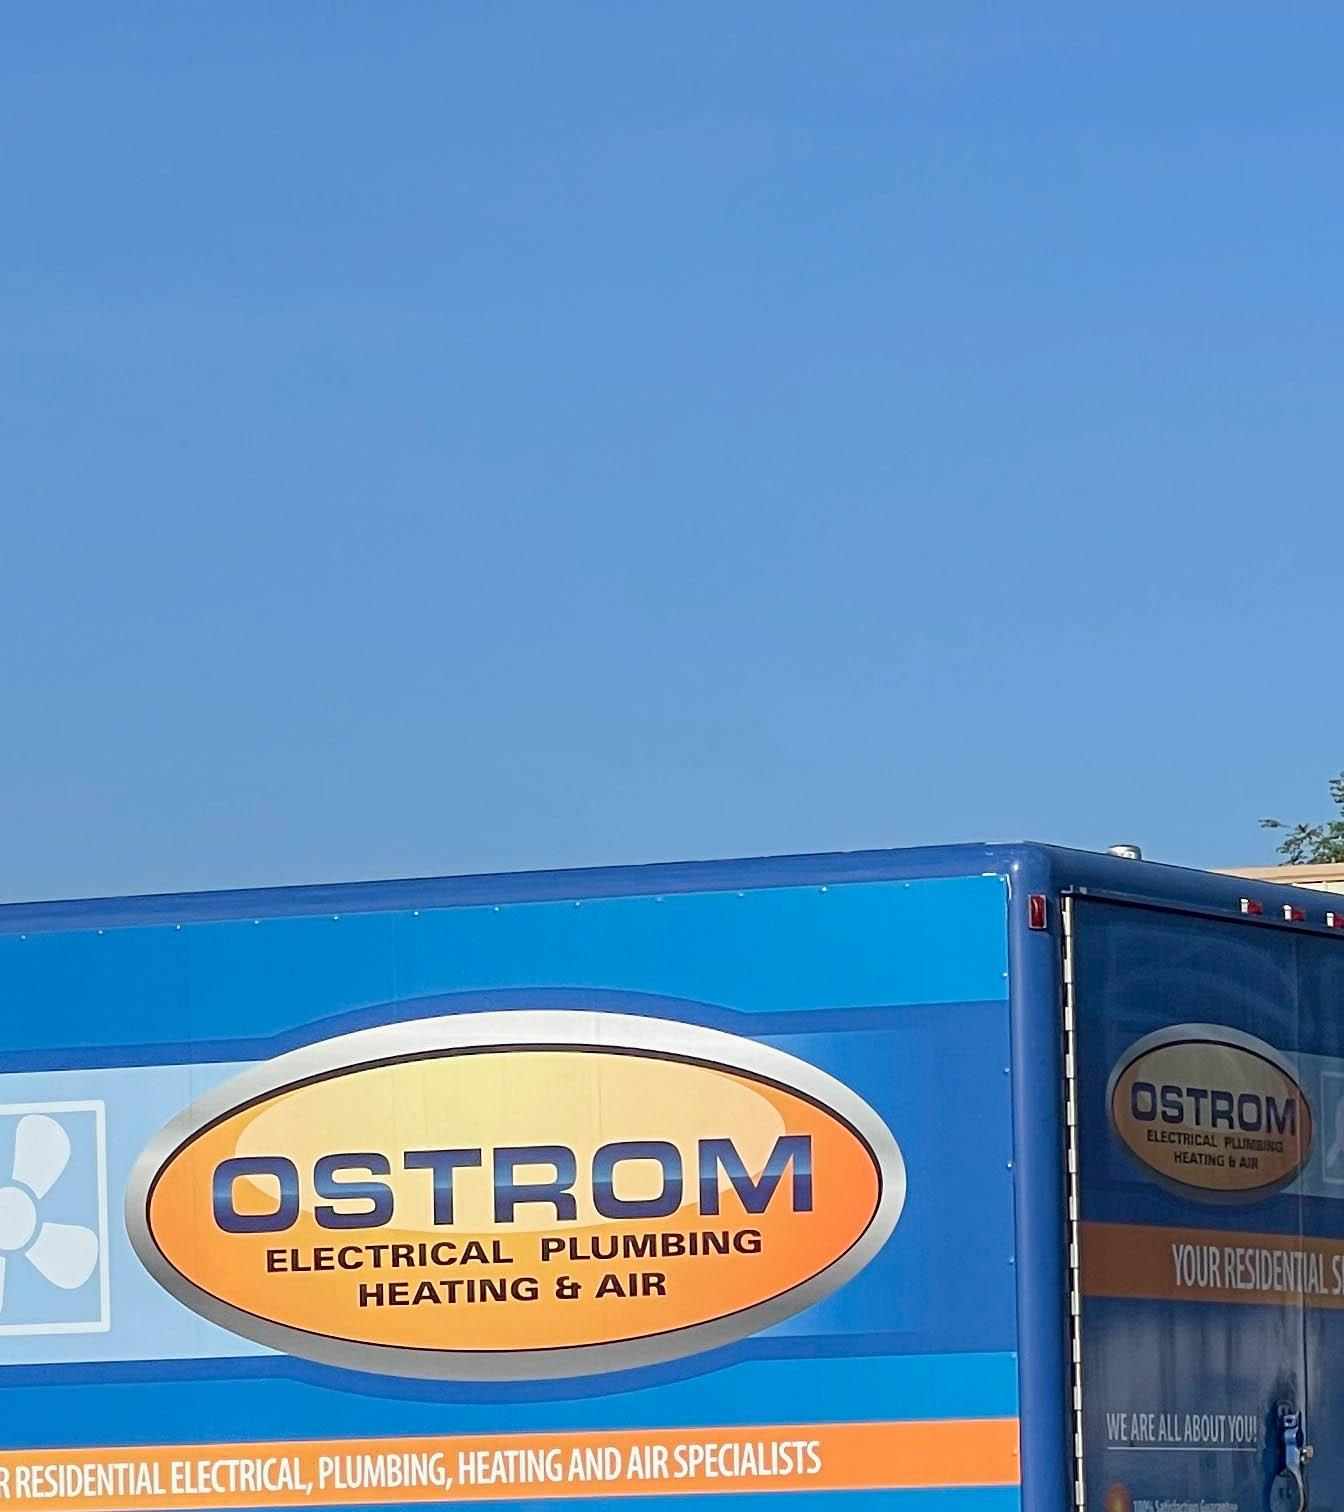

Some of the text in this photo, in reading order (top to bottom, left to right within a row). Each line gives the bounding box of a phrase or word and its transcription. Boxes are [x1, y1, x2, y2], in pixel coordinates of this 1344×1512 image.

[1131, 1082, 1296, 1137] OSTROM
[1147, 1130, 1284, 1153] ELECTRICAL PLUMBING
[1174, 1151, 1259, 1170] HEATING & AIR
[212, 1135, 813, 1234] OSTROM
[266, 1229, 762, 1273] ELECTRICAL PLUMBING
[1172, 1243, 1221, 1288] YOUR
[1224, 1247, 1328, 1295] RESIDENTIAL
[358, 1272, 667, 1308] HEATING & AIR
[1106, 1413, 1257, 1443] WE ARE ALL ABOUT YOU!
[16, 1462, 166, 1499] RESIDENTIAL
[171, 1458, 313, 1496] ELECTRICAL,
[319, 1452, 453, 1490] PLUMBING,
[458, 1449, 563, 1486] HEATING
[567, 1447, 622, 1482] AND
[627, 1445, 669, 1481] AIR
[674, 1440, 822, 1479] SPECIALISTS
